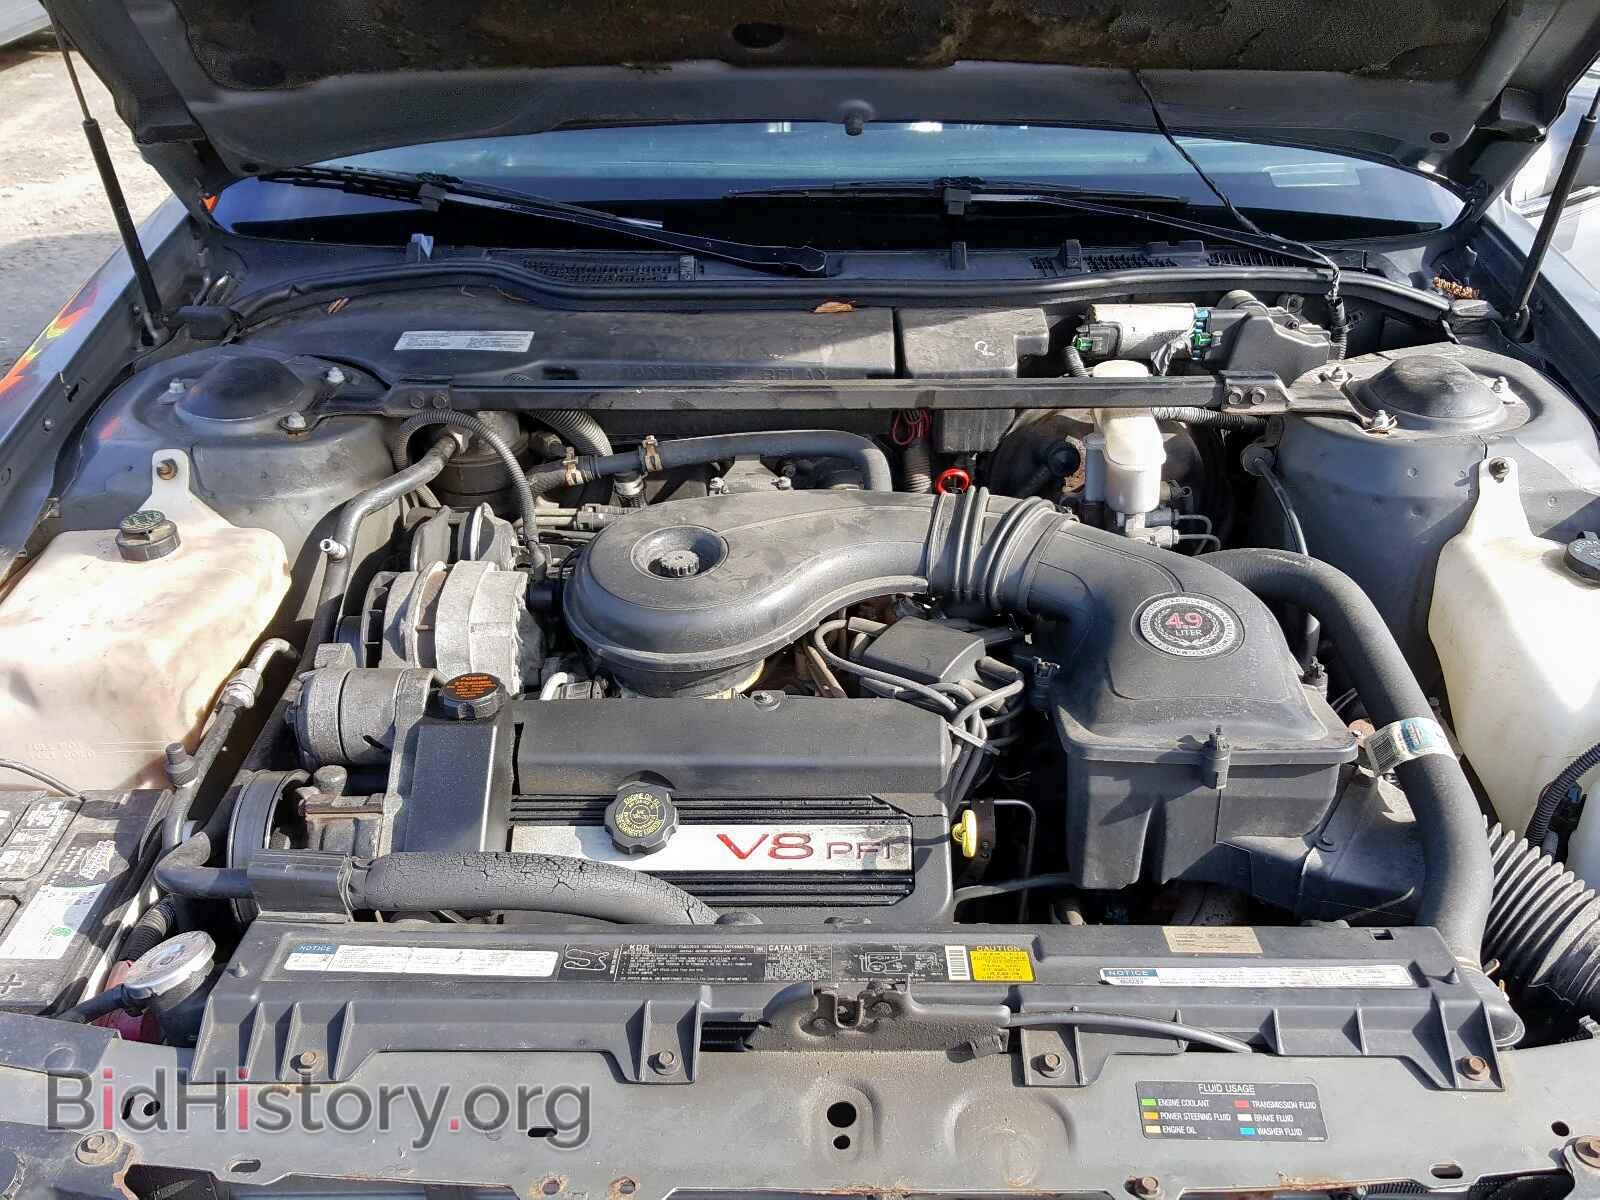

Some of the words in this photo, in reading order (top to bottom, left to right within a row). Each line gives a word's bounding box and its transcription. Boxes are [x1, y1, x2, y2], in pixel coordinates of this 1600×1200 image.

[1175, 629, 1202, 637] LITER
[716, 832, 814, 860] V8
[826, 841, 892, 860] PFI
[1198, 1083, 1222, 1093] FLUID
[1224, 1083, 1255, 1094] USAGE
[1158, 1098, 1180, 1107] ENGINE
[1181, 1099, 1209, 1107] COOLANT
[1252, 1100, 1298, 1109] TRANSMISSION
[1299, 1101, 1317, 1109] FLUID
[1160, 1112, 1182, 1120] POWER
[1183, 1112, 1213, 1121] STEERING
[1213, 1113, 1232, 1121] FLUID
[1254, 1114, 1275, 1122] BRAKE
[1275, 1114, 1294, 1122] FLUID
[1162, 1125, 1185, 1135] ENGINE
[1186, 1126, 1198, 1135] OIL
[1256, 1127, 1284, 1136] WASHER
[1284, 1128, 1303, 1136] FLUID
